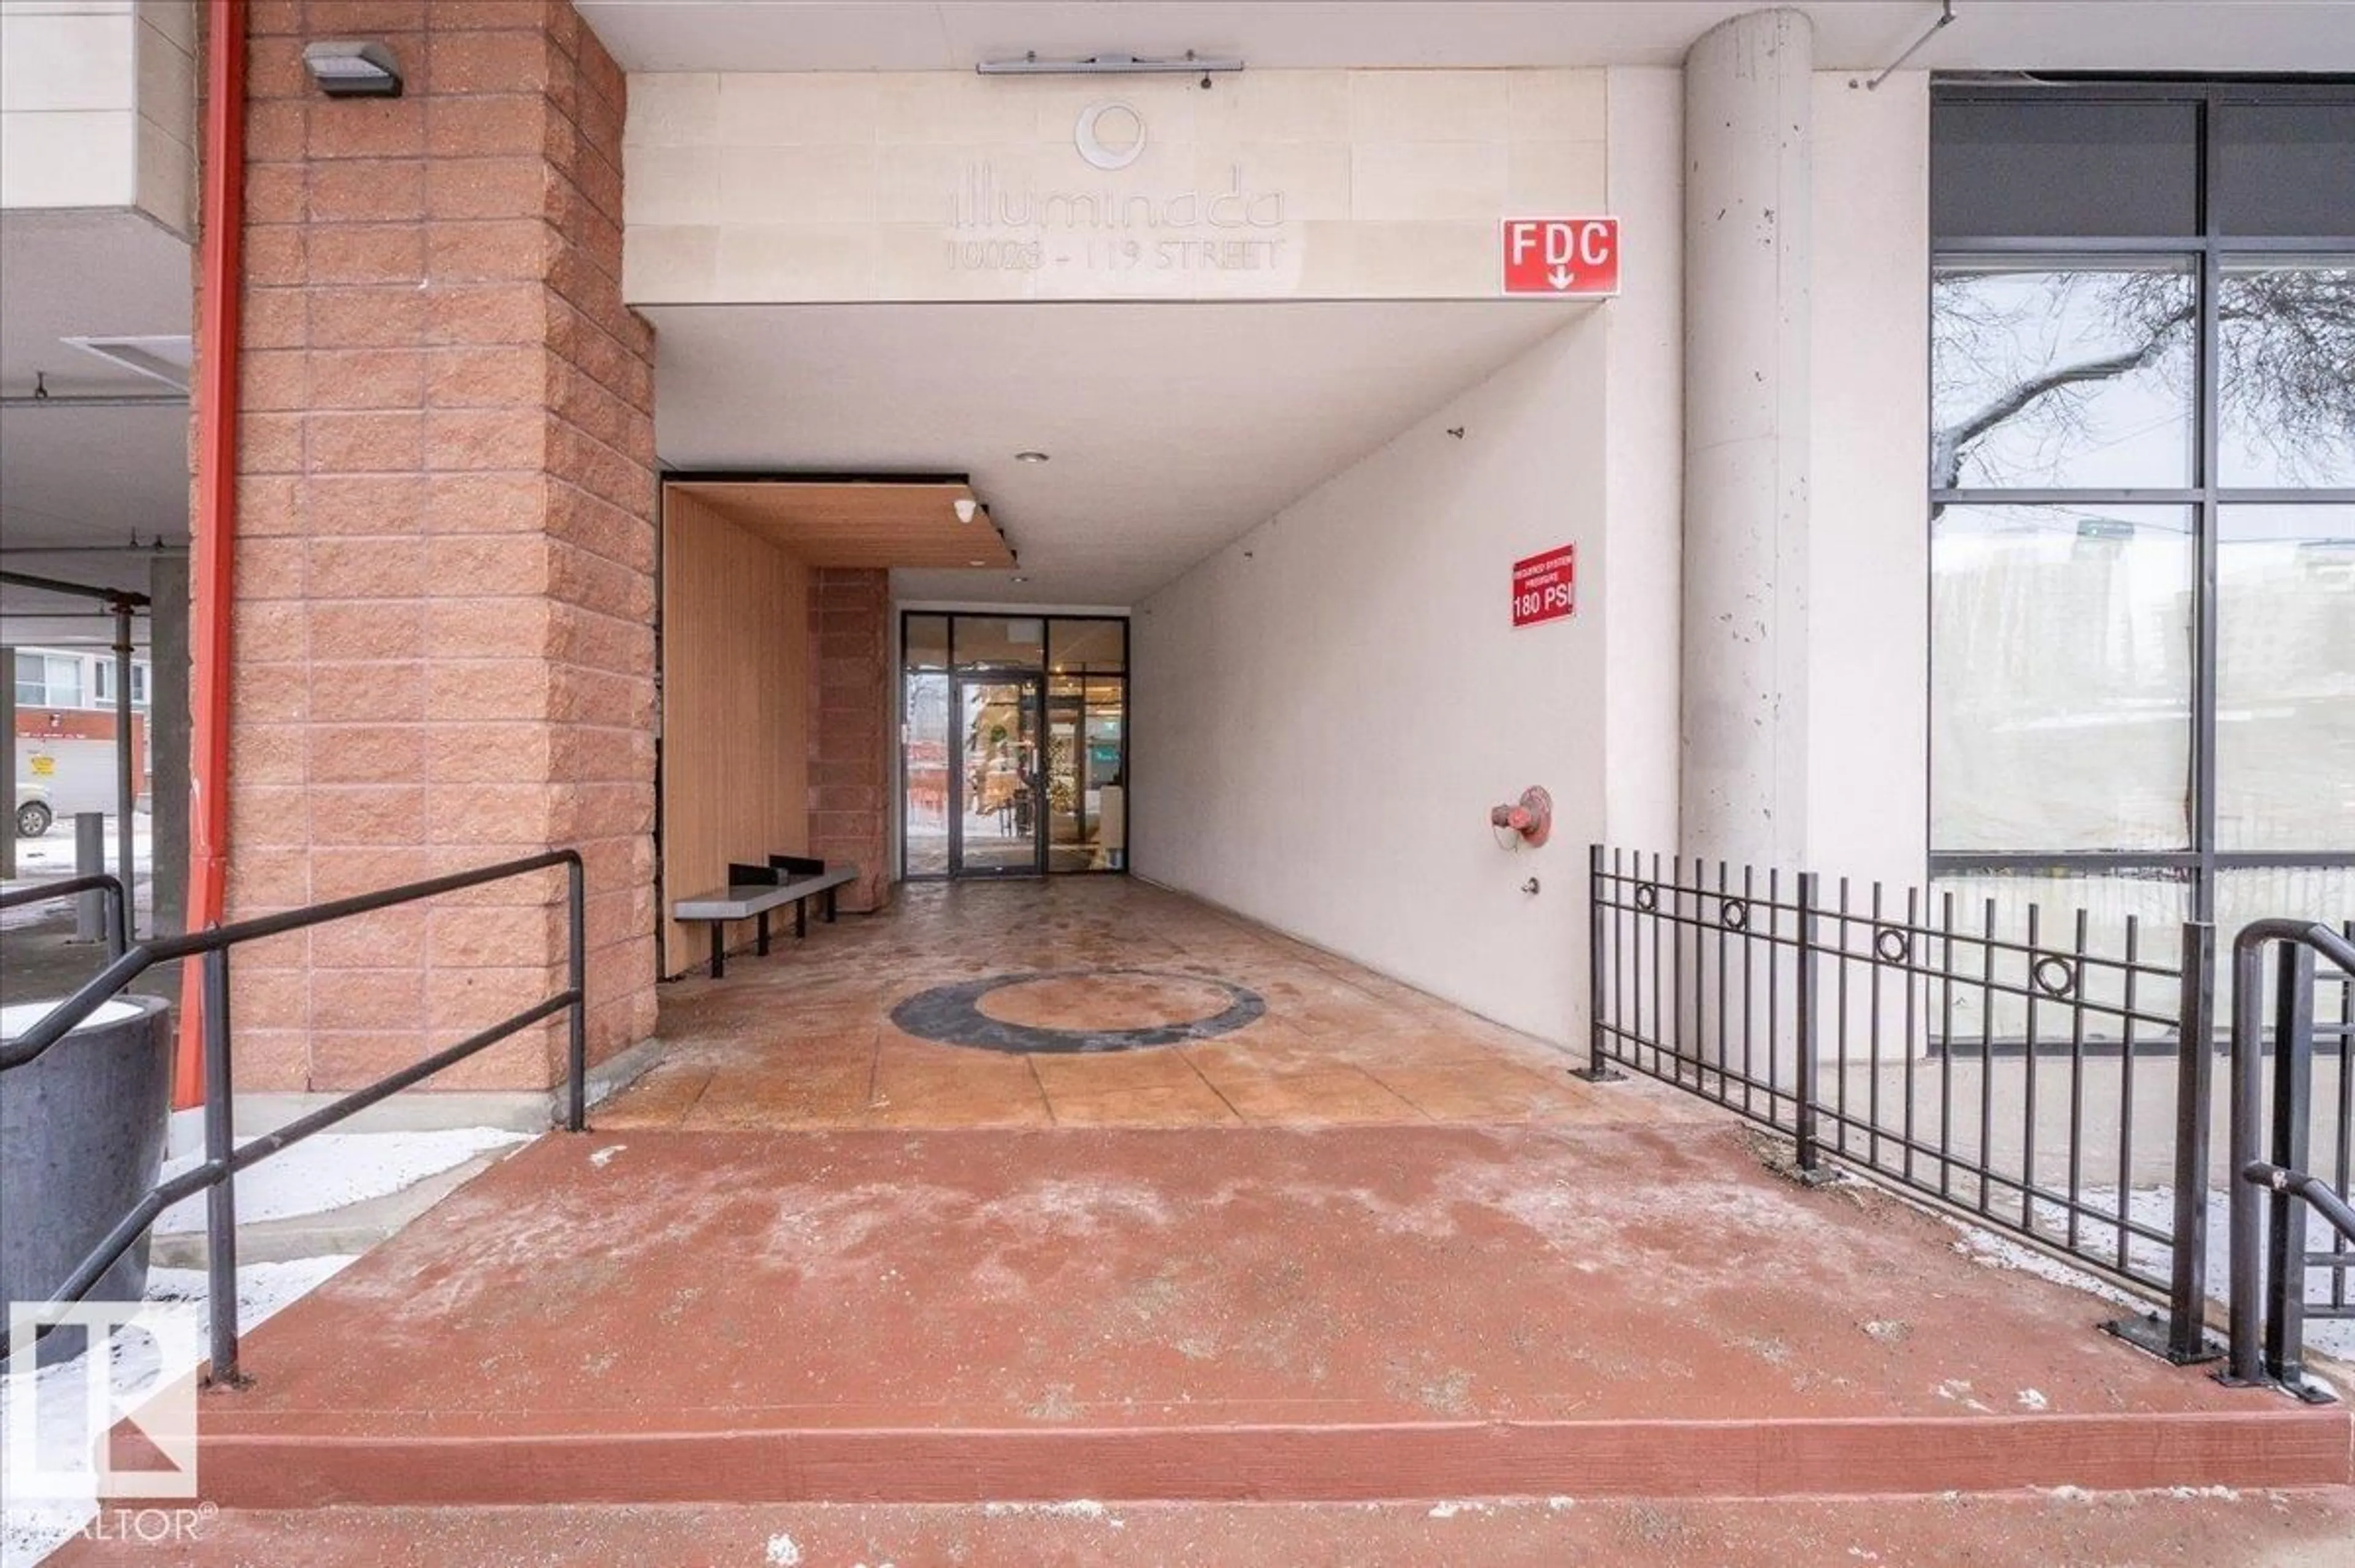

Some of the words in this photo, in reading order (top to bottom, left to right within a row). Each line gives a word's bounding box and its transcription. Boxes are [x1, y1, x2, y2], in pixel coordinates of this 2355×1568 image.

[1086, 240, 1141, 270] 119
[1158, 240, 1285, 270] STREET
[1512, 222, 1609, 266] FDC
[1514, 592, 1541, 618] 180
[1544, 582, 1572, 610] PSI
